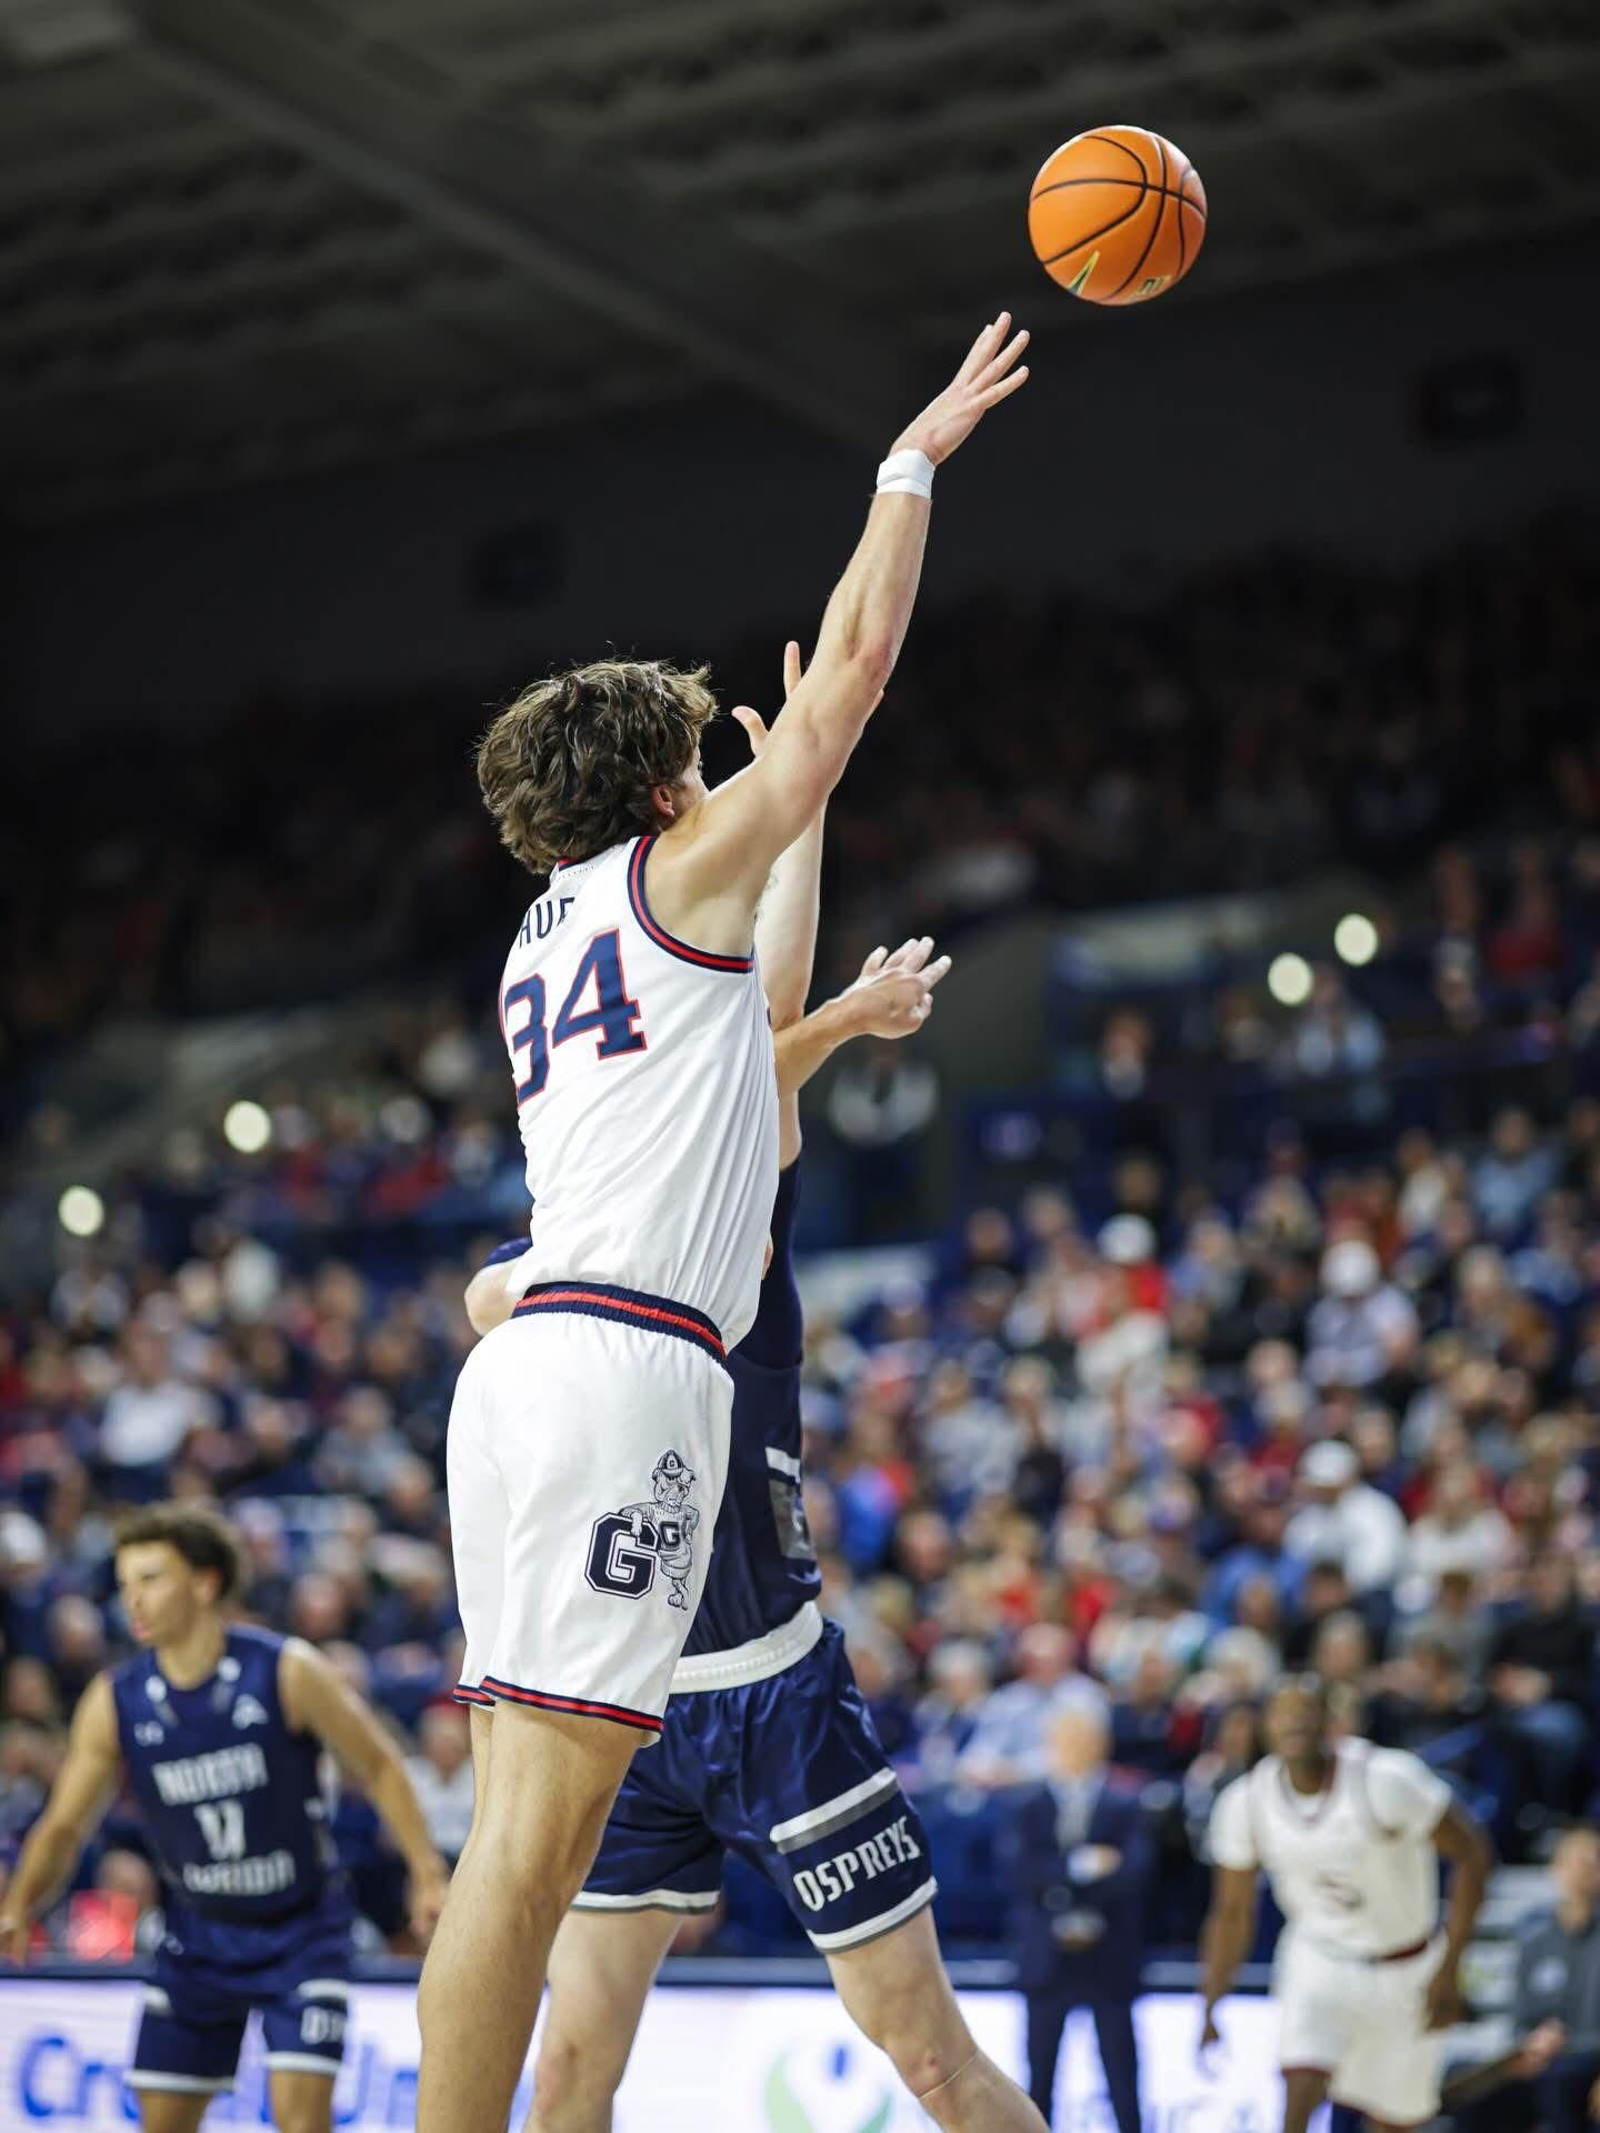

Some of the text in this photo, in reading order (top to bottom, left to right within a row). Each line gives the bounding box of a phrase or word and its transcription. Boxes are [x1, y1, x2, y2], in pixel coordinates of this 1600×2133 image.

[500, 928, 648, 1107] 34
[584, 1512, 661, 1600] G
[659, 1521, 681, 1547] G
[793, 1815, 921, 1912] OSPREYS
